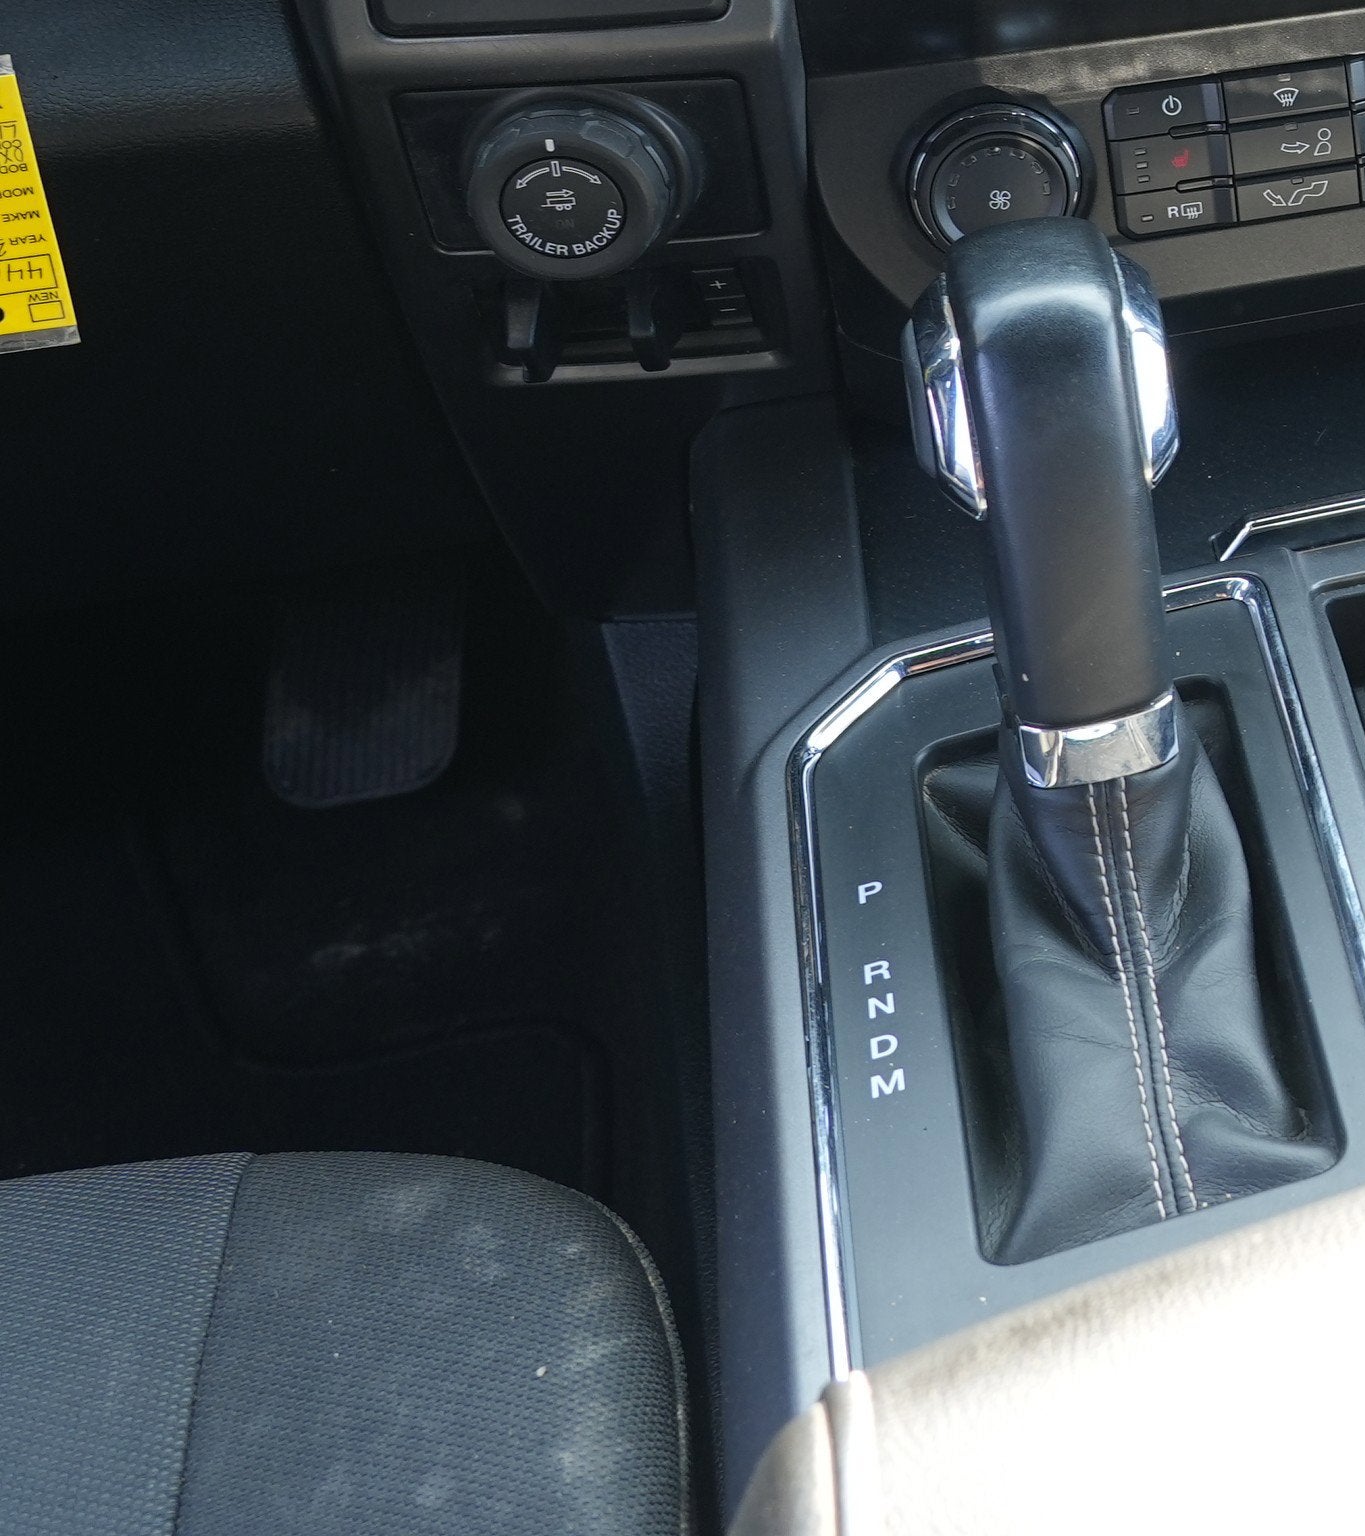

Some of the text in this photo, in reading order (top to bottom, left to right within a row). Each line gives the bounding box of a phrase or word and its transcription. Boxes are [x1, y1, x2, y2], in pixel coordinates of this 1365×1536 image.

[2, 210, 41, 223] MAKE
[1167, 205, 1180, 219] R
[9, 234, 47, 246] YEAR
[507, 208, 623, 256] TRAILER BACKUP
[29, 291, 59, 303] NEW
[858, 881, 883, 904] P
[863, 960, 892, 985] R
[867, 993, 896, 1019] N
[869, 1034, 899, 1060] D
[870, 1068, 906, 1099] M
